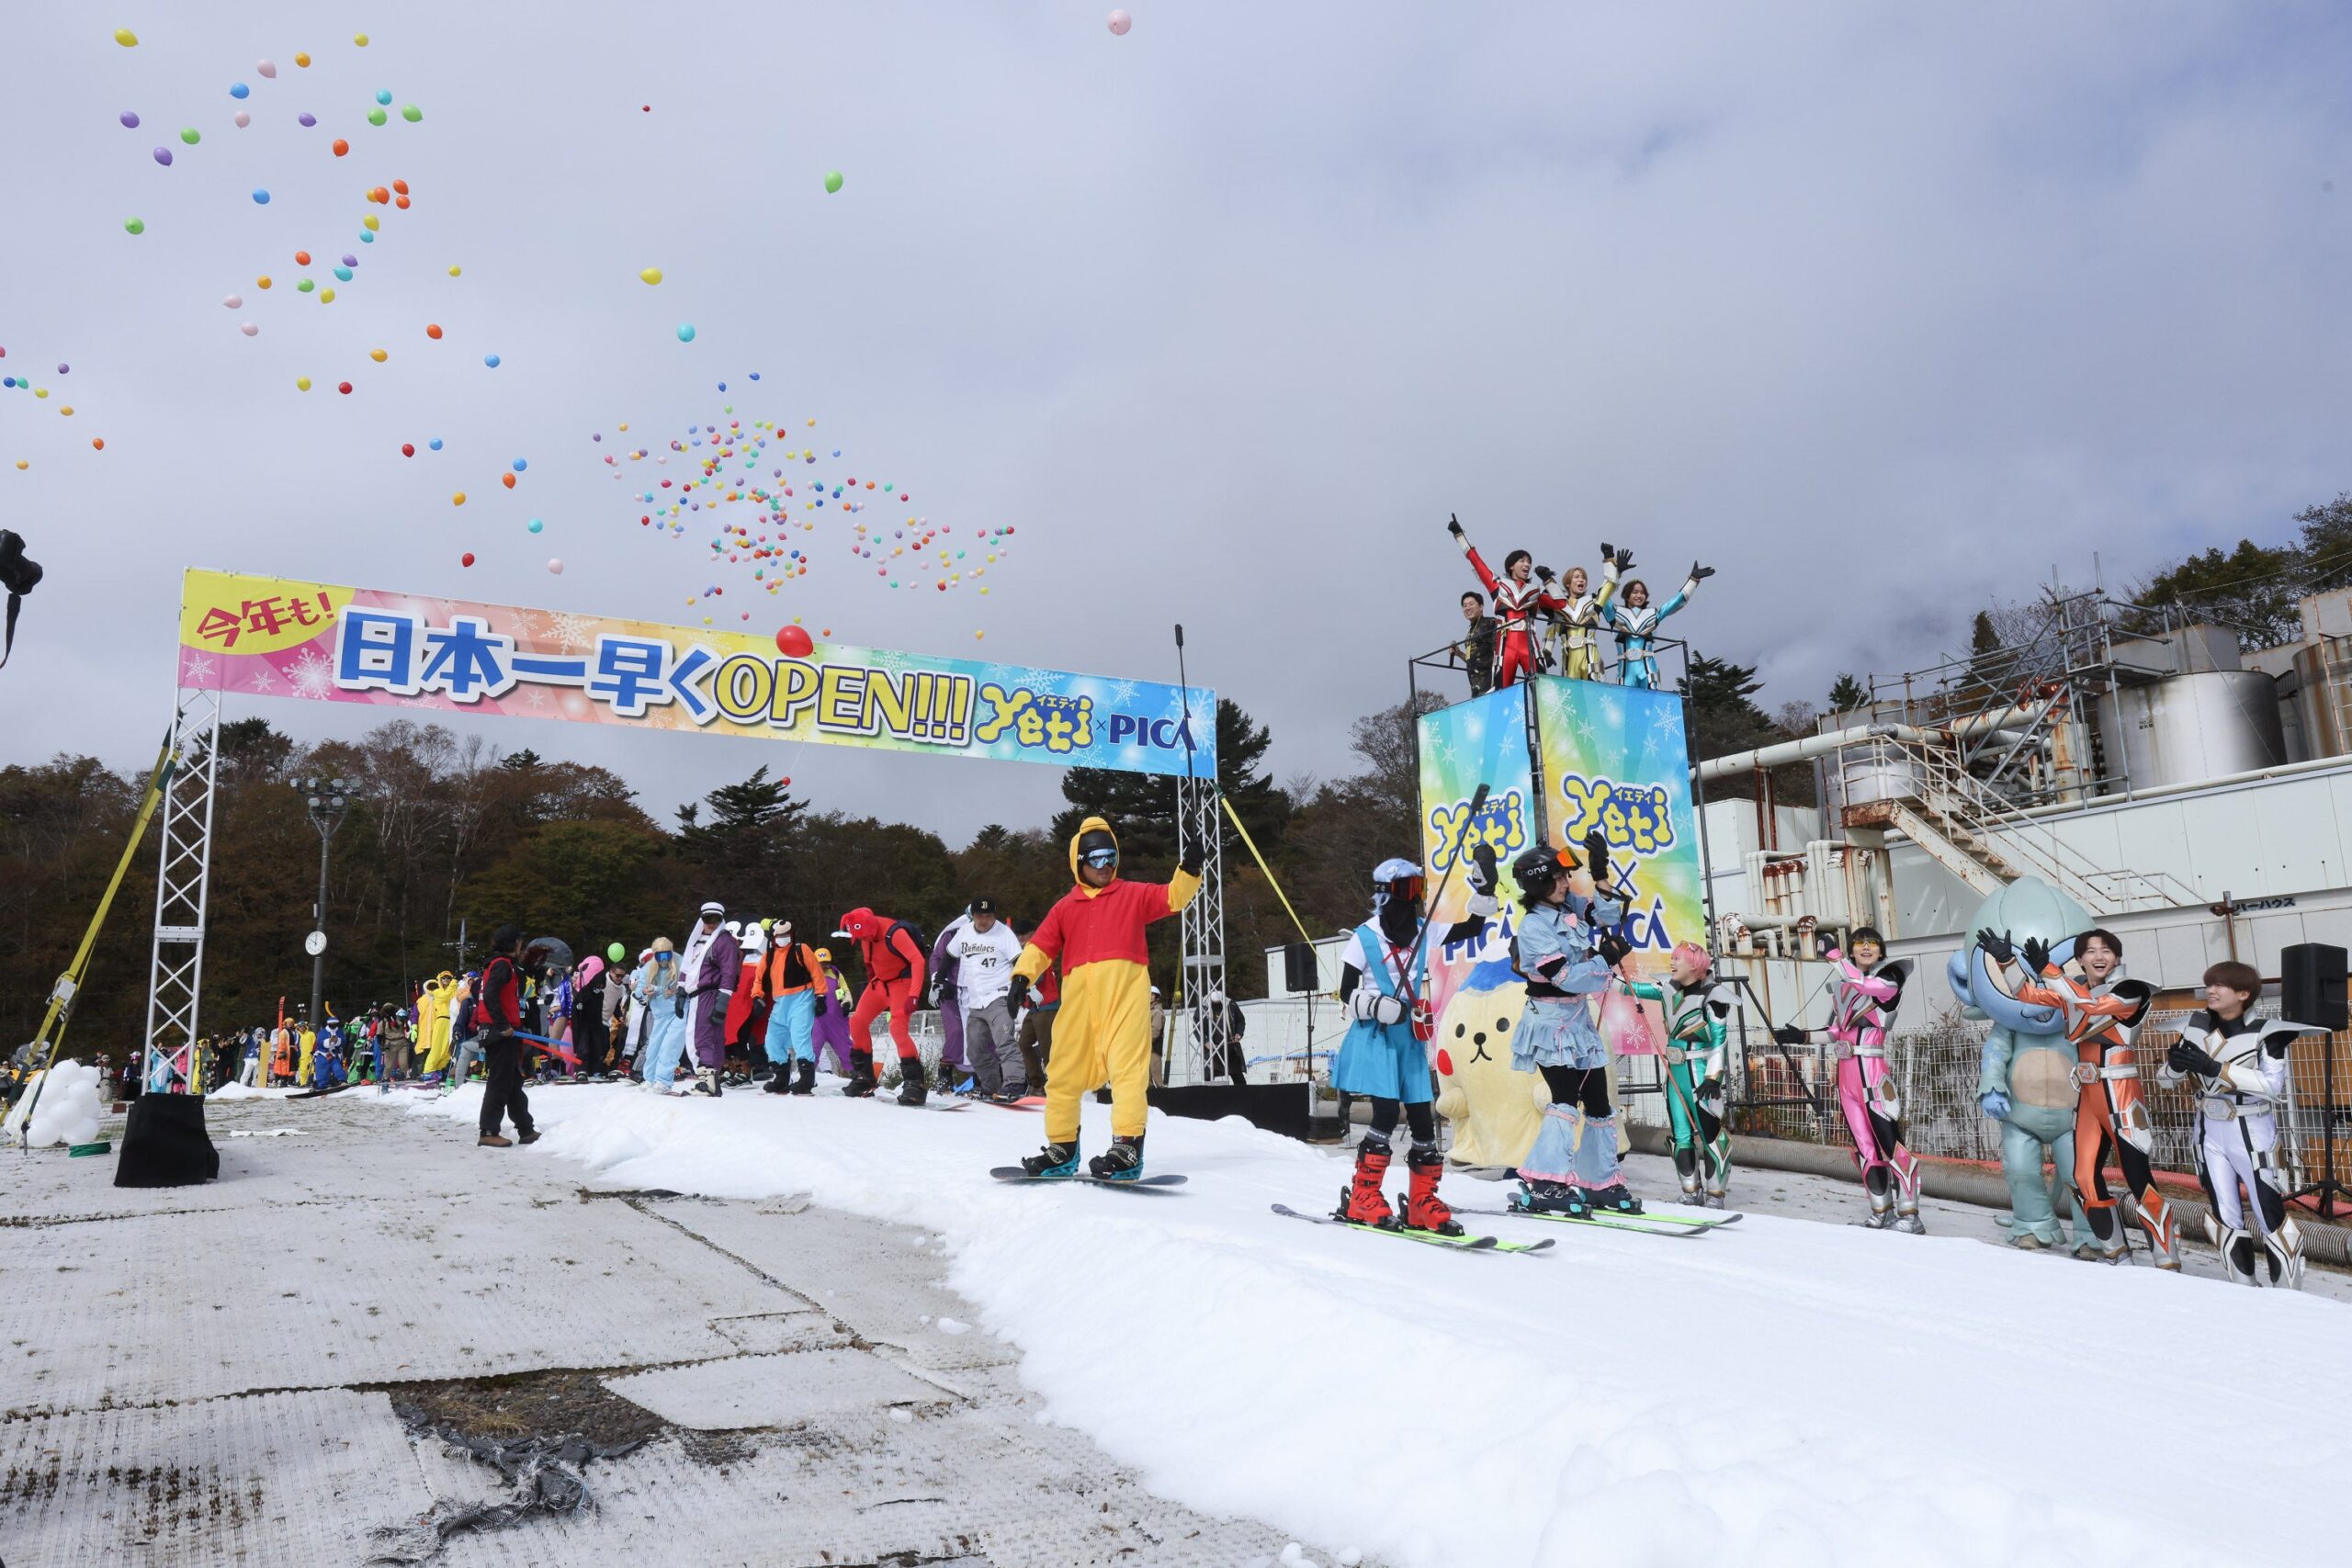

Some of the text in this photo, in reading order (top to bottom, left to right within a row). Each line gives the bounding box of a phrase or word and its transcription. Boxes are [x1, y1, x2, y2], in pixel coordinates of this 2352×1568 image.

[196, 591, 333, 648] 今年も!
[975, 682, 1093, 753] Yeti
[1110, 708, 1198, 751] PICA
[1037, 694, 1078, 711] イエティ
[1476, 800, 1506, 817] エティ
[1615, 787, 1651, 804] イエティ
[1431, 791, 1525, 871] Yeti
[1564, 775, 1674, 854] Yeti
[981, 957, 997, 968] 47
